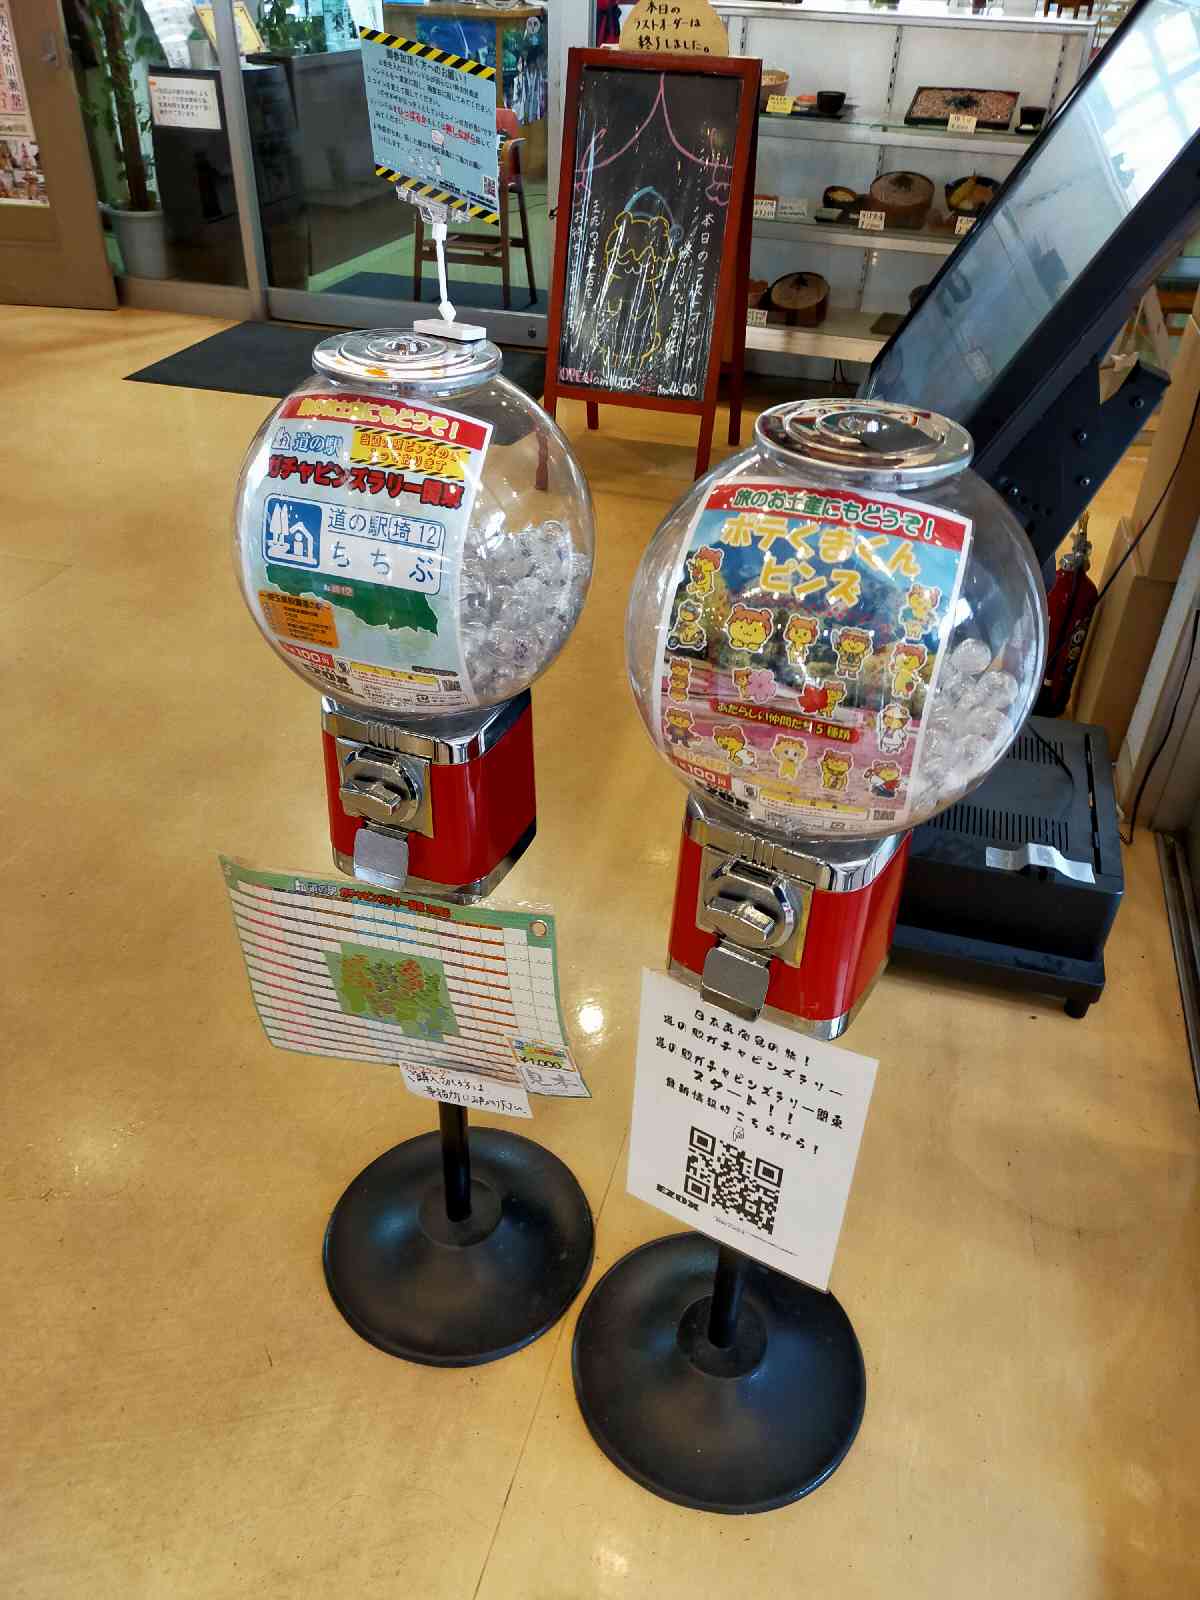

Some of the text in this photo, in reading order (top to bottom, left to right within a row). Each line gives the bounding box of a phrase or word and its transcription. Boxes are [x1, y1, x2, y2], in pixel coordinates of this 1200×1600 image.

[646, 0, 681, 14] 本日の
[638, 34, 711, 53] 終了しました。
[327, 507, 390, 538] 道の駅
[732, 488, 937, 539] 旅のお土産にもどうぞ！
[332, 541, 435, 584] ちちぶ
[759, 556, 863, 609] ピンズ
[663, 1014, 844, 1097] 道の駅ガチャピンズラリー
[655, 1036, 844, 1130] 道の駅ガチャピンズラリー関東
[665, 1077, 819, 1155] 最新情報はこちらから！
